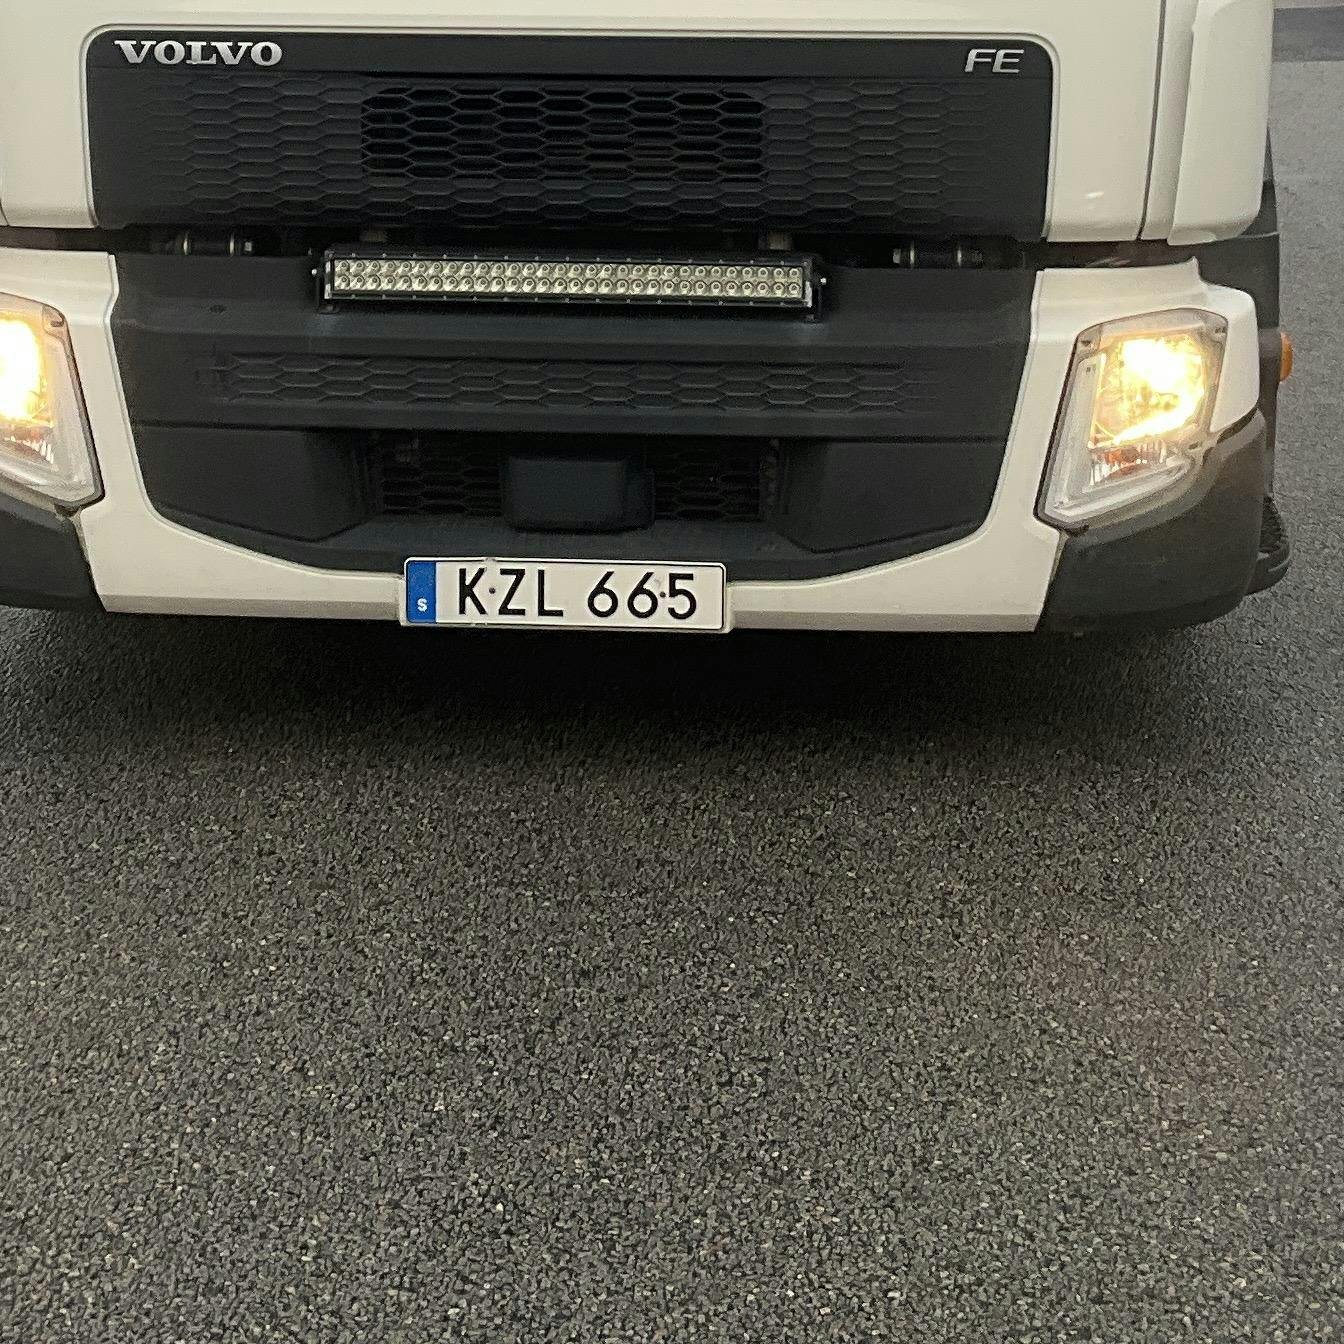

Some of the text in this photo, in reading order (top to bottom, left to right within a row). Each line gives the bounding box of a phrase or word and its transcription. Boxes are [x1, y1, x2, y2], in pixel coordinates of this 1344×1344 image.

[113, 40, 283, 66] VOLVO
[964, 48, 1025, 73] FE
[417, 598, 428, 612] S
[458, 567, 697, 620] KZL 665
